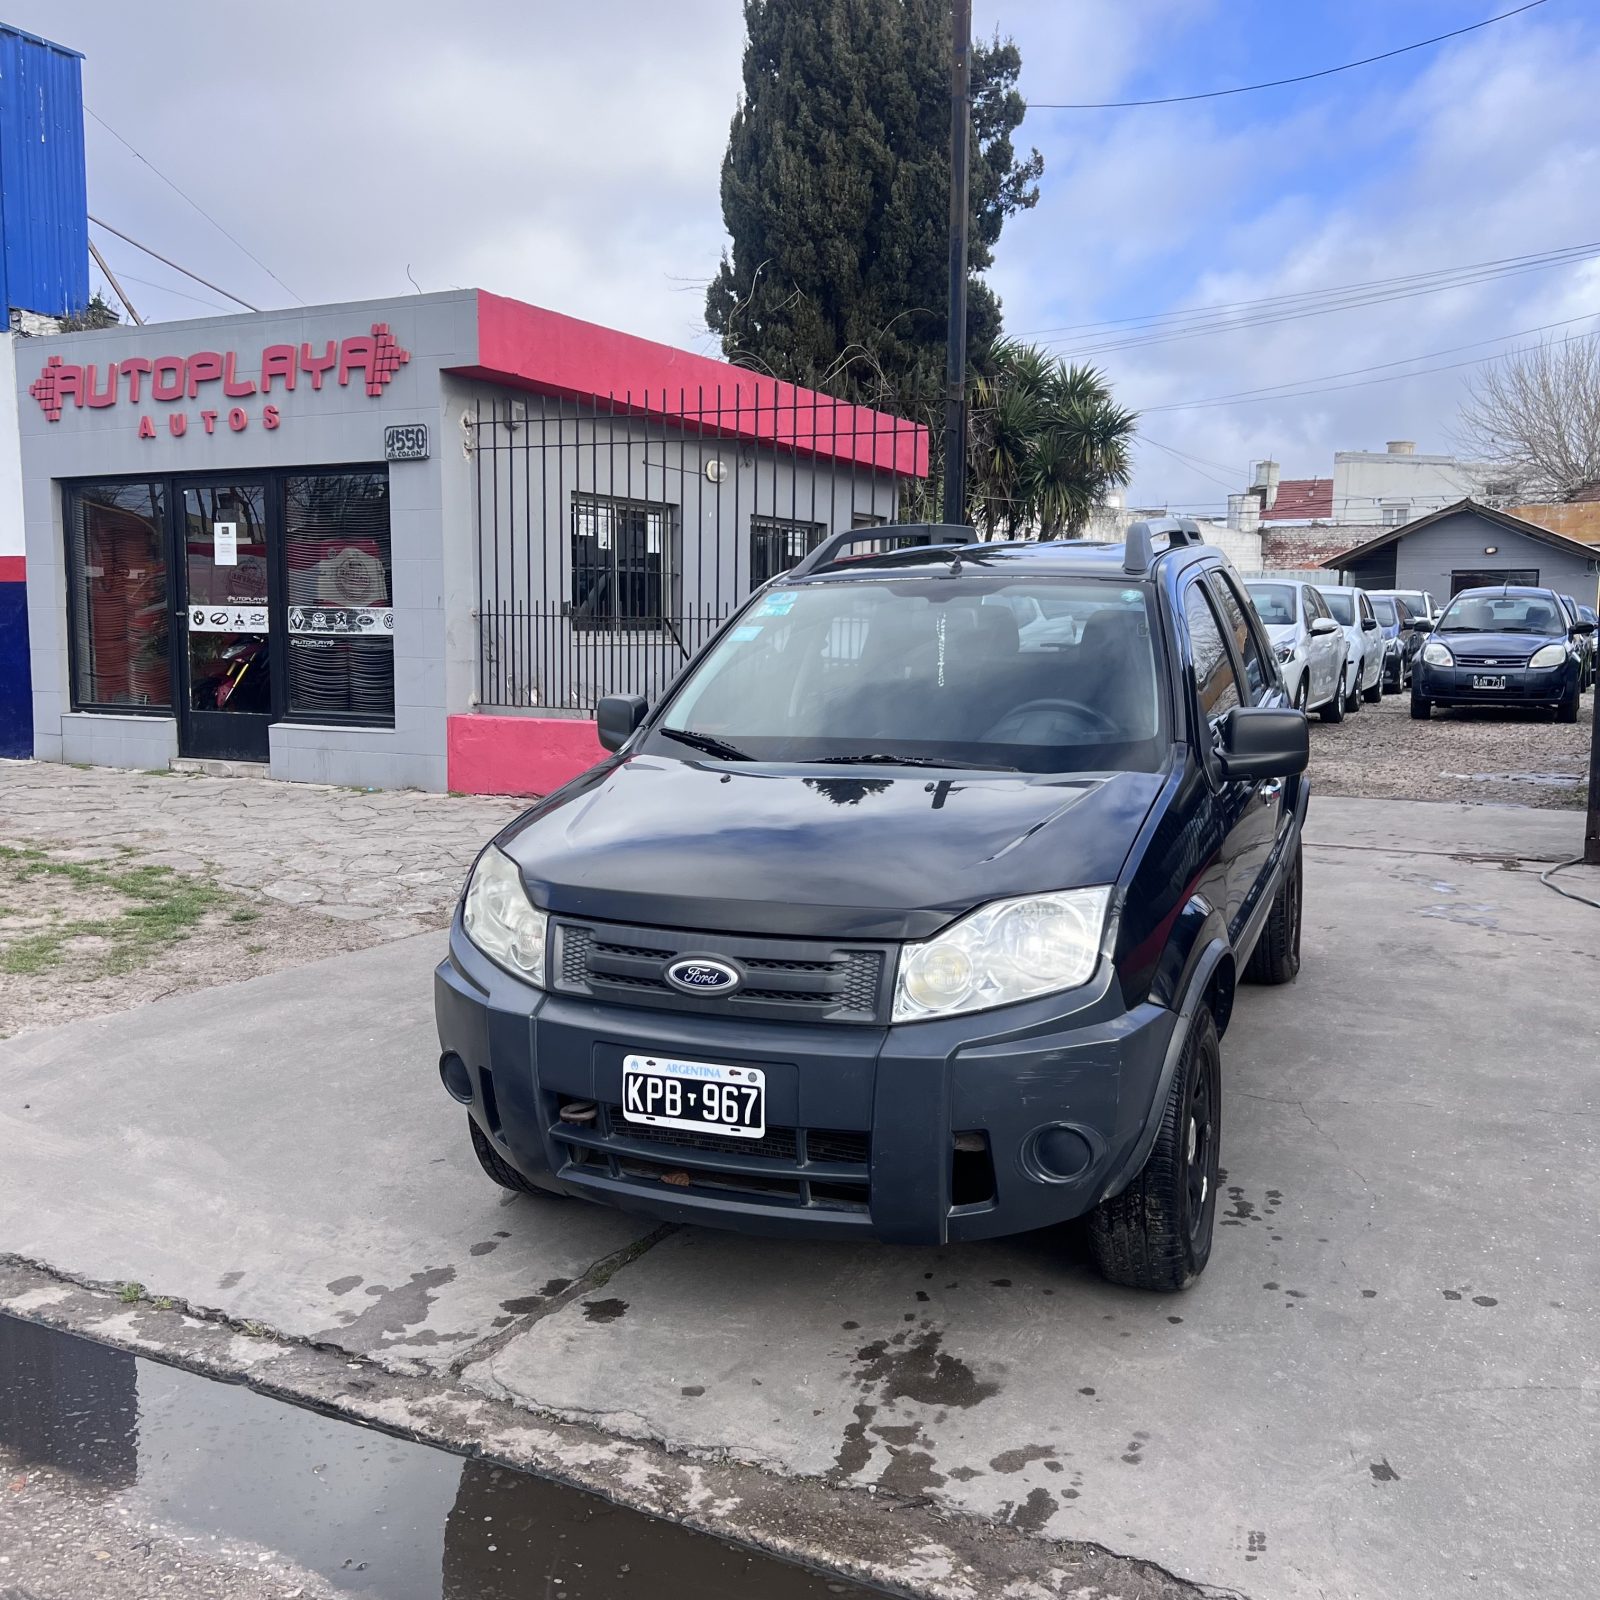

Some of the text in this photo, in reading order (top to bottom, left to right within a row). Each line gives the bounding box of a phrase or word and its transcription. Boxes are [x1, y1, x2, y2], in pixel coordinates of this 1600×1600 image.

[53, 336, 379, 409] AUTOPLAYA
[138, 405, 280, 438] AUTOS
[386, 428, 425, 451] 4550
[684, 966, 719, 984] Ford
[665, 1063, 721, 1078] ARGENTINA
[628, 1075, 758, 1125] KPB 967
